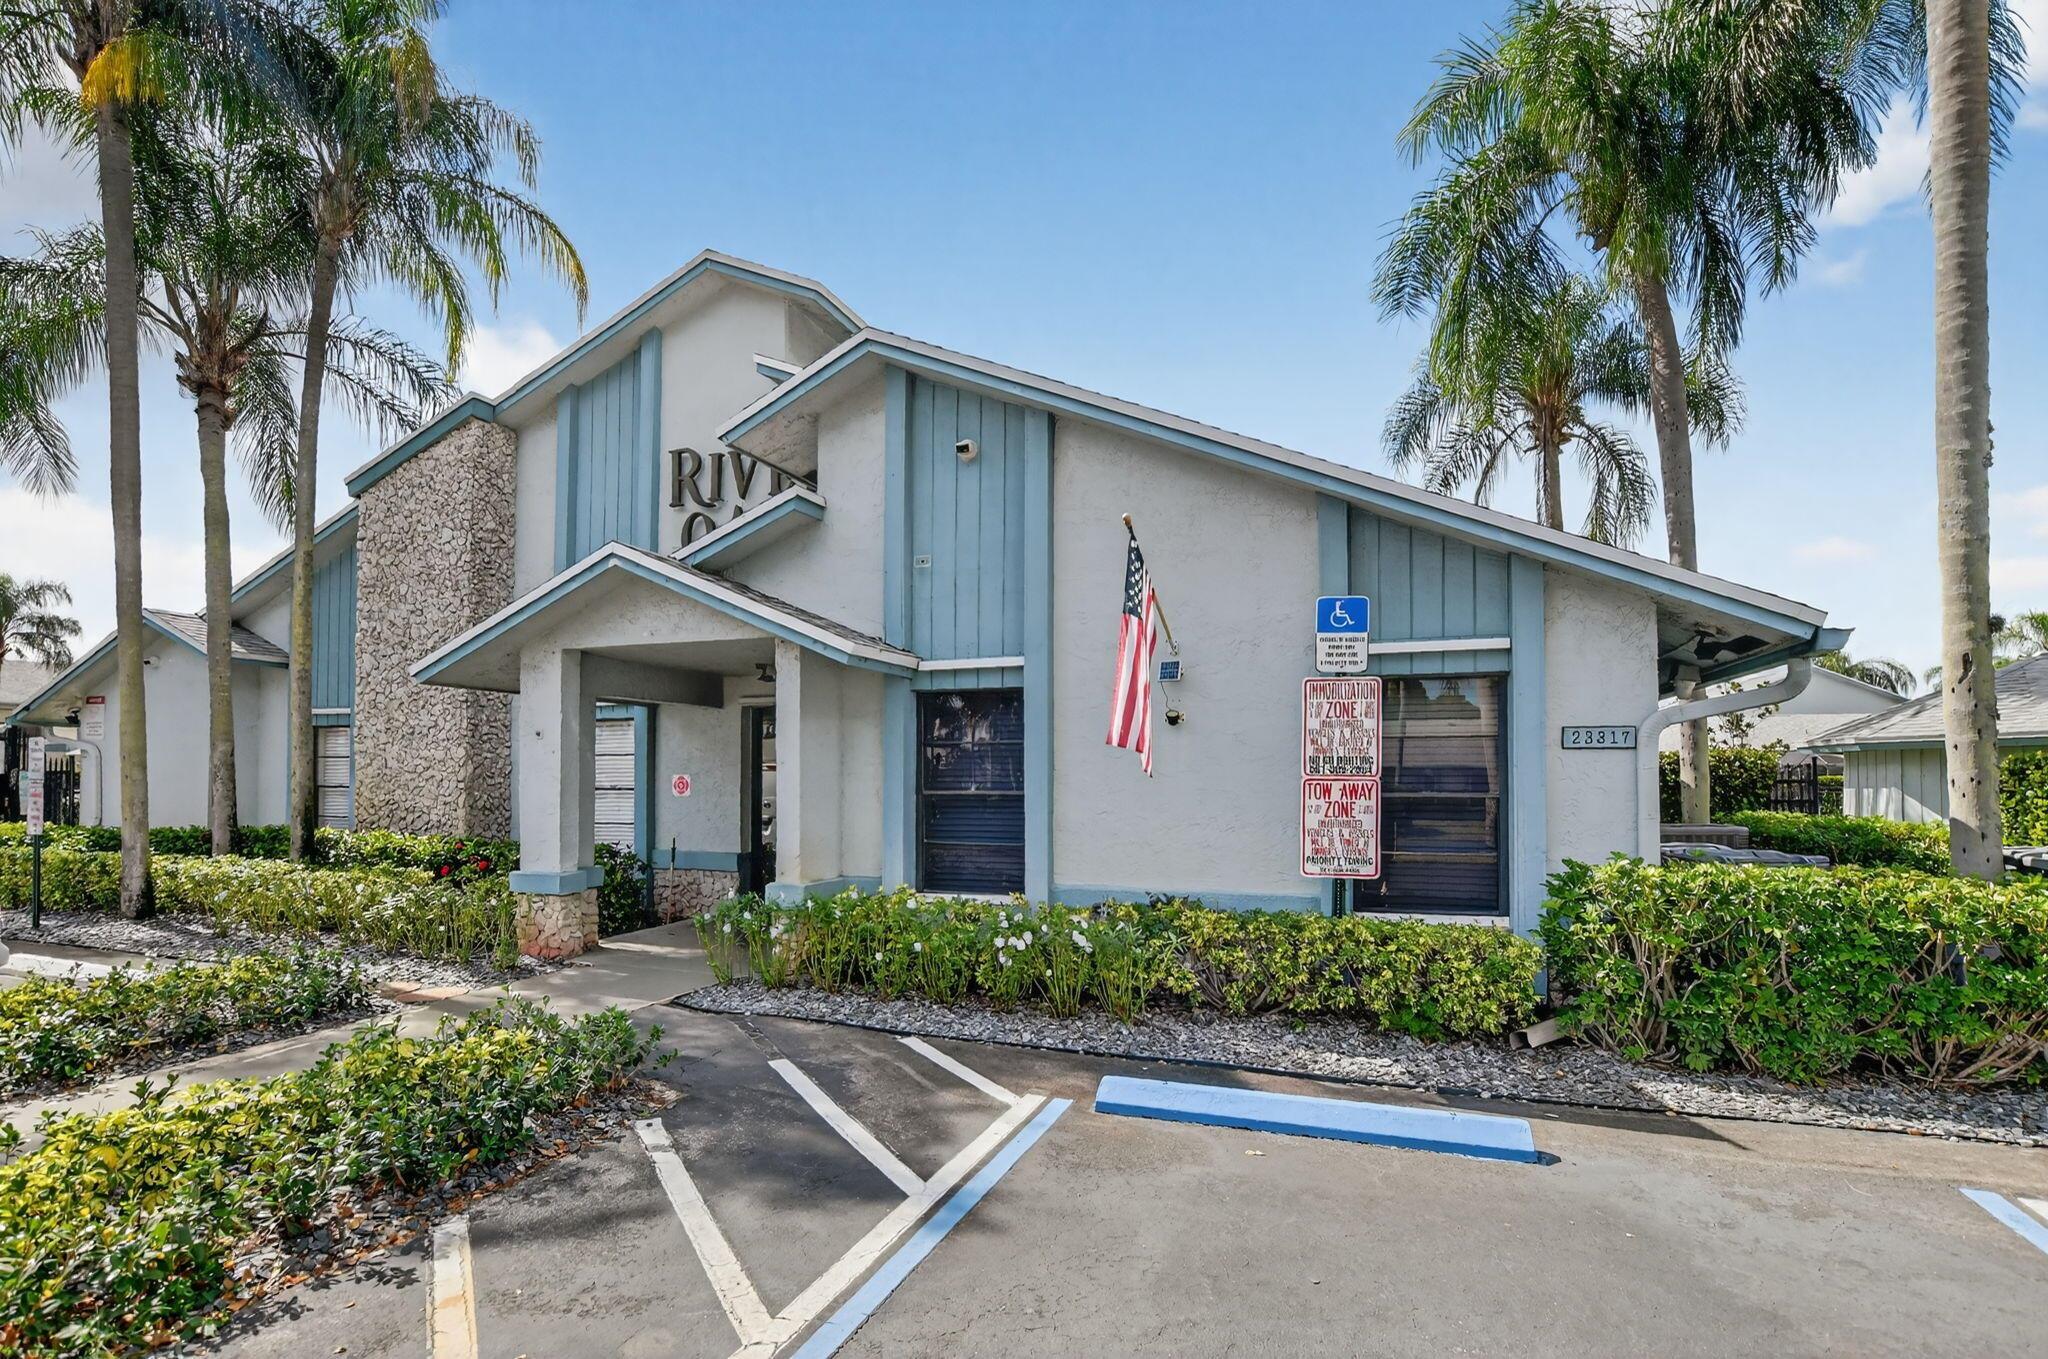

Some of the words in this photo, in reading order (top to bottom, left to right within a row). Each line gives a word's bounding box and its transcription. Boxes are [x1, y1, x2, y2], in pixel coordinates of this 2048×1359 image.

[1326, 701, 1358, 719] ZONE
[1572, 730, 1630, 745] 23317
[1307, 782, 1333, 800] TOW
[1340, 782, 1375, 800] AWAY
[1324, 800, 1356, 818] ZONE
